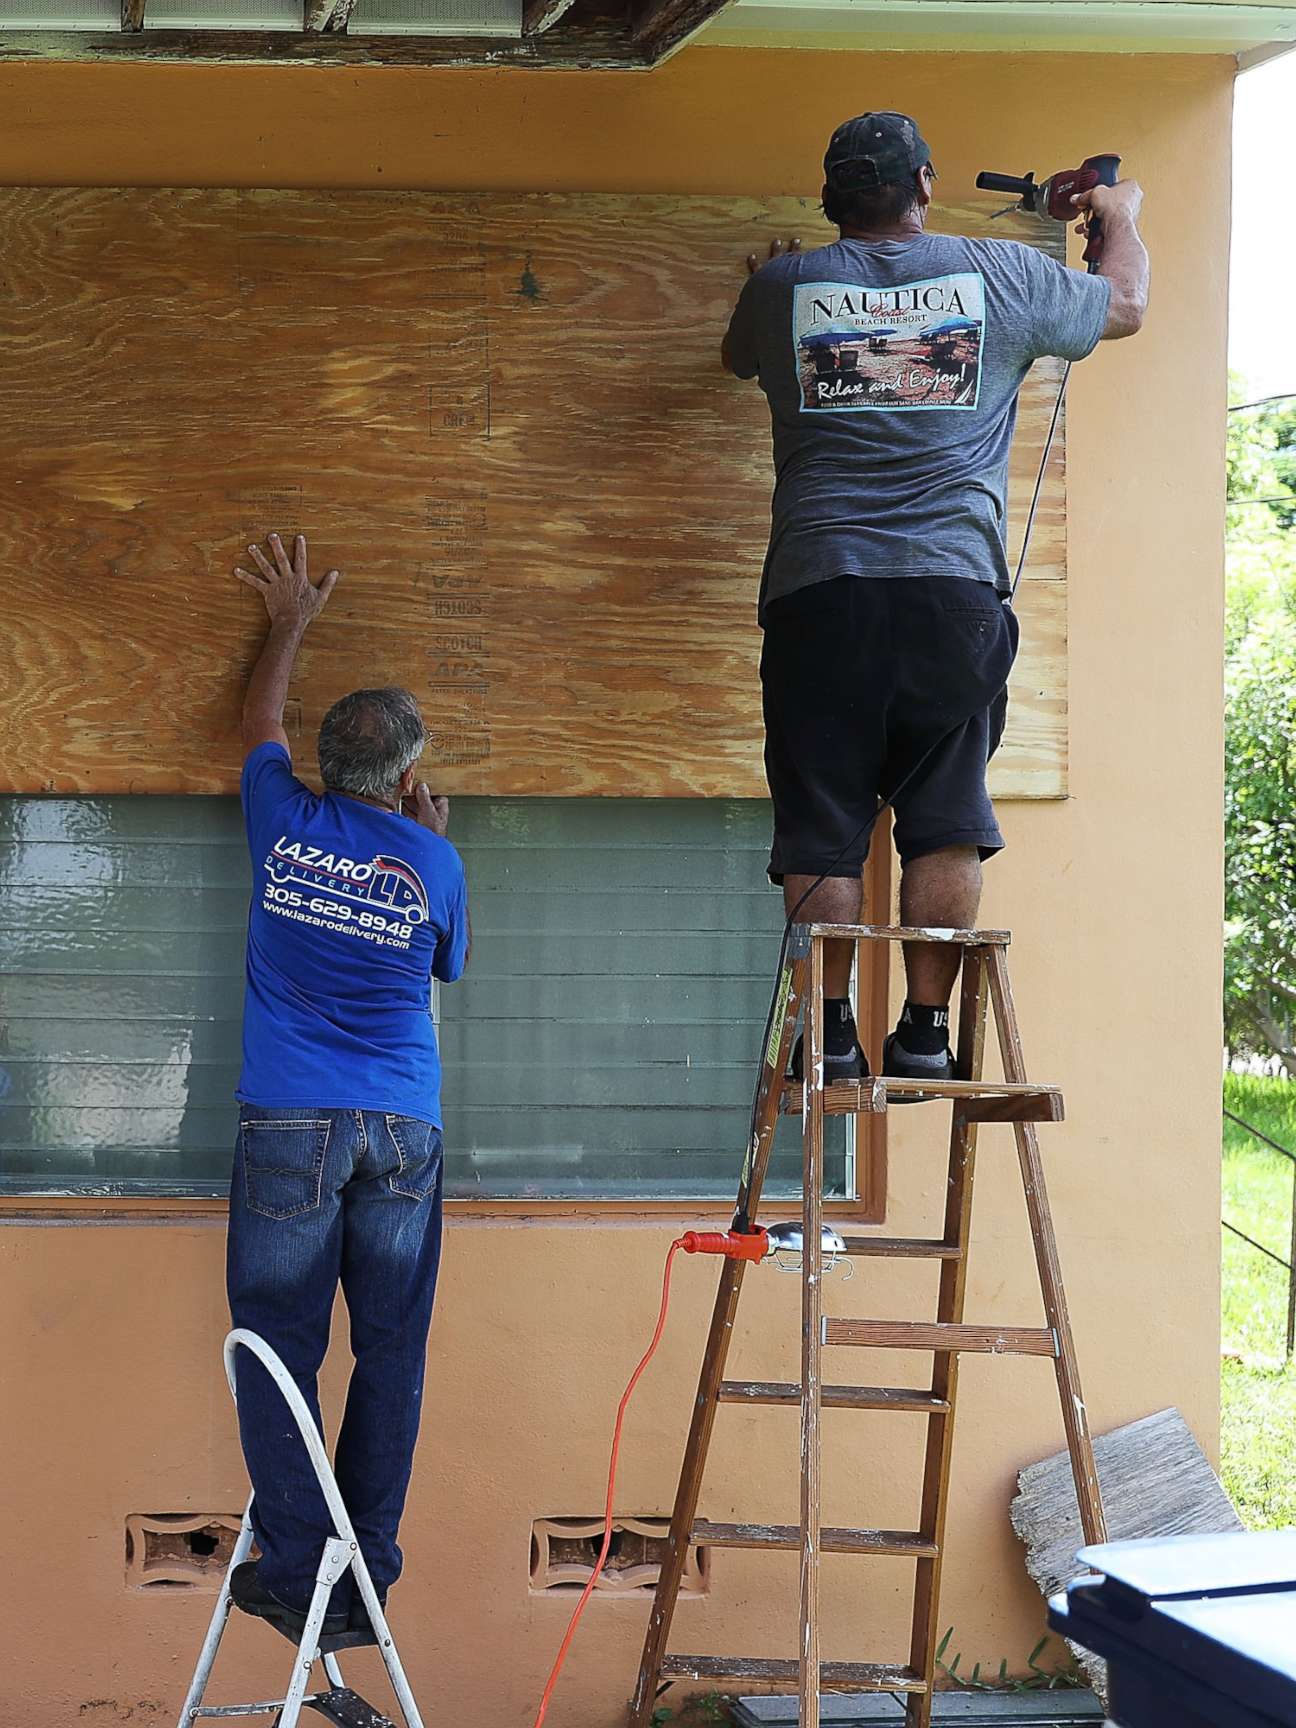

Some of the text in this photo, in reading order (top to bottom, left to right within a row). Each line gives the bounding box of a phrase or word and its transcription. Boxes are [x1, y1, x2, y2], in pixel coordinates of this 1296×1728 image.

[810, 287, 968, 326] NAUTICA
[855, 314, 928, 326] BEACH RESORT
[817, 363, 966, 399] Relax and Enjoy!
[266, 855, 365, 896] DELIVERY
[273, 835, 373, 882] LAZARO
[262, 900, 410, 950] www.lazarodelivery.com
[264, 883, 414, 940] 305-629-8948
